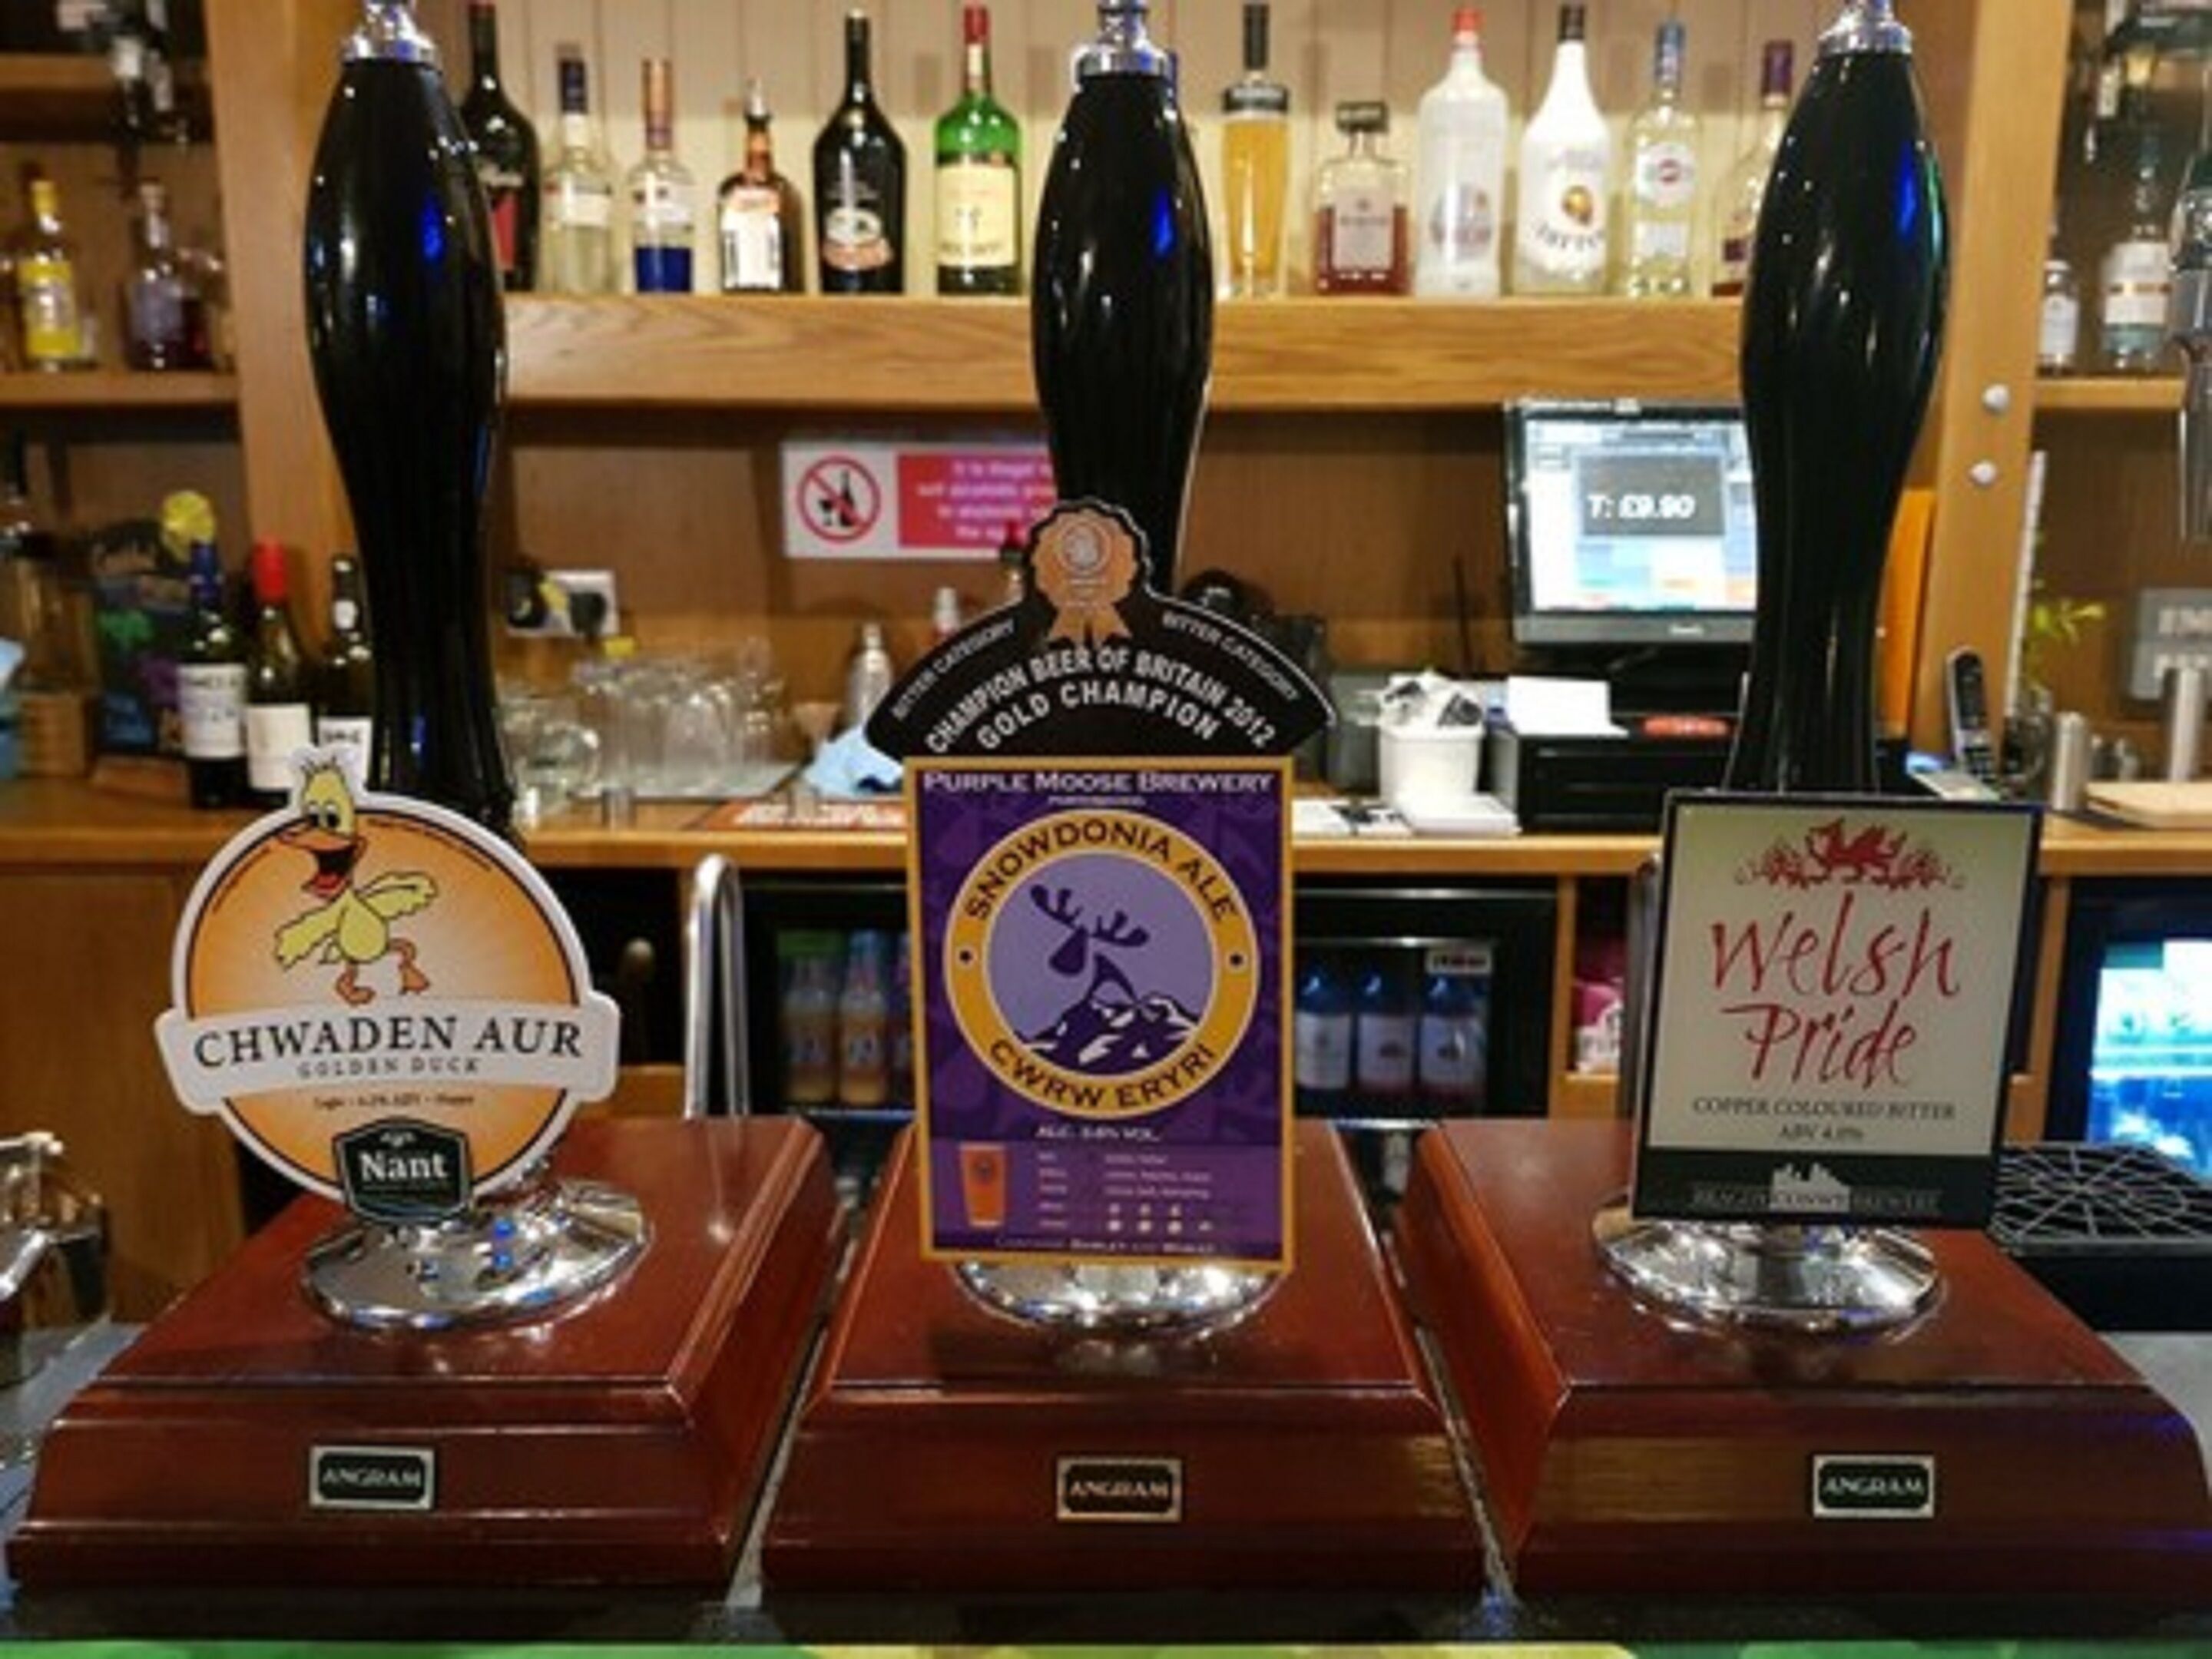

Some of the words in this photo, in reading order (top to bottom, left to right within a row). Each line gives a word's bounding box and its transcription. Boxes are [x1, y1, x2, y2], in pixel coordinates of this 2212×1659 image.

[932, 620, 1015, 675] CATEGORY
[1161, 611, 1220, 647] BITTER
[1219, 636, 1300, 701] CATEGORY
[925, 667, 1028, 753] CHAMPION
[1030, 644, 1092, 680] BEER
[1097, 645, 1129, 671] OF
[1135, 649, 1228, 706] BRITAIN
[1223, 700, 1277, 749] 2012
[976, 694, 1051, 750] GOLD
[1061, 679, 1221, 741] CHAMPION
[923, 772, 1028, 792] PURPLE
[1035, 772, 1133, 792] MOOSE
[1137, 772, 1275, 792] BREWERY
[967, 818, 1171, 921] SNOWDONIA
[1177, 857, 1237, 922] ALE
[1712, 889, 1961, 997] Welsh
[193, 1015, 458, 1068] CHWADEN
[474, 1022, 583, 1057] AUR
[297, 1058, 399, 1078] GOLDEN
[411, 1055, 482, 1073] DUCK
[1721, 999, 1918, 1091] Pride
[990, 1039, 1104, 1108] CWRW
[1116, 1041, 1216, 1109] ERYRI
[1693, 1097, 1769, 1116] COPPER
[1773, 1098, 1883, 1118] COLOURED
[359, 1151, 448, 1181] Nant
[322, 1468, 422, 1488] ANGRAM
[1070, 1480, 1170, 1498] ANGRAM
